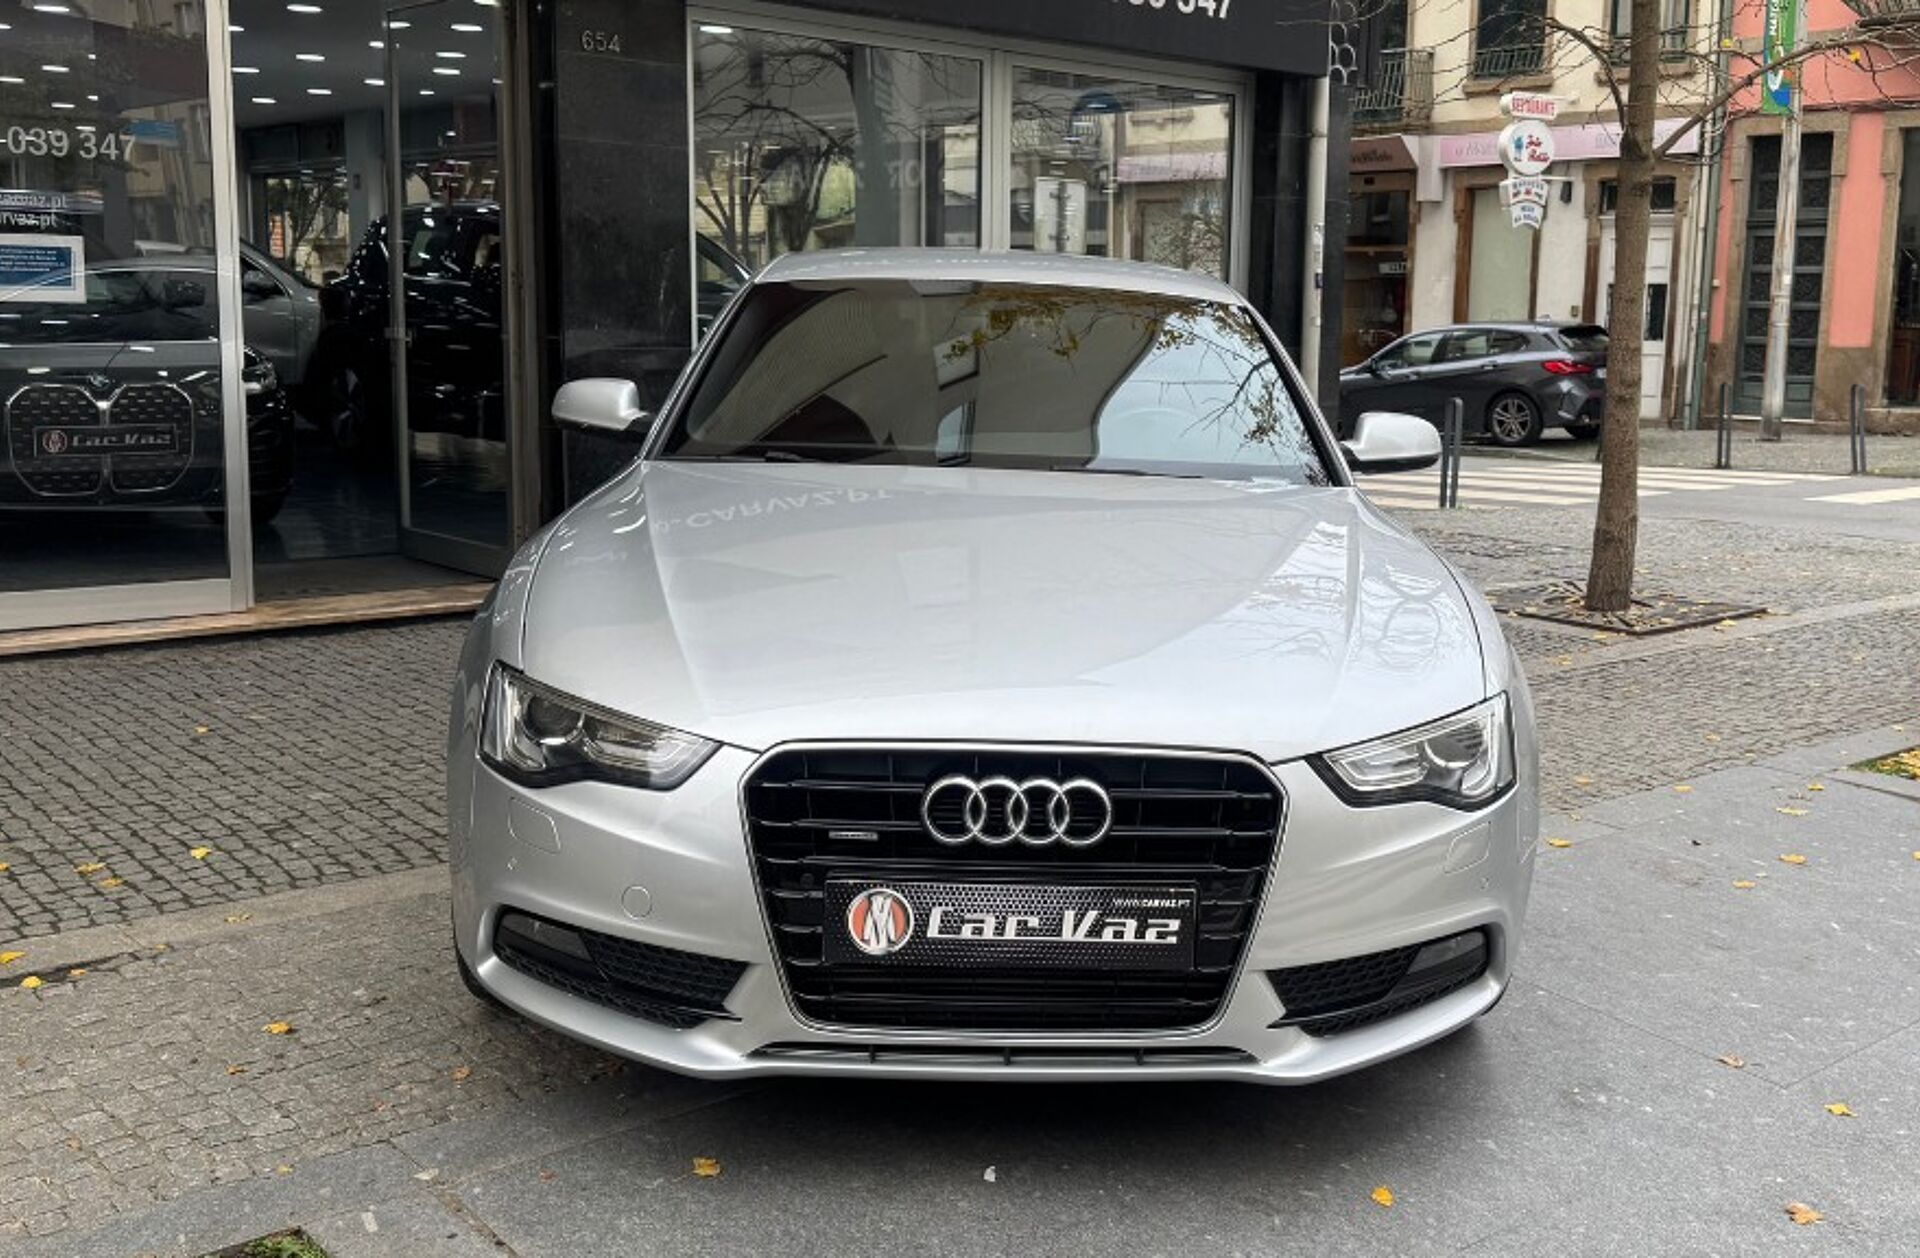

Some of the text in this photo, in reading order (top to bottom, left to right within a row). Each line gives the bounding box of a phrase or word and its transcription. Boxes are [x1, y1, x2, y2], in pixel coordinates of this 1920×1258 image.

[582, 30, 620, 53] 654
[7, 126, 136, 161] 039 347
[73, 433, 171, 447] Car Vaz
[926, 906, 1181, 944] Car Vaz
